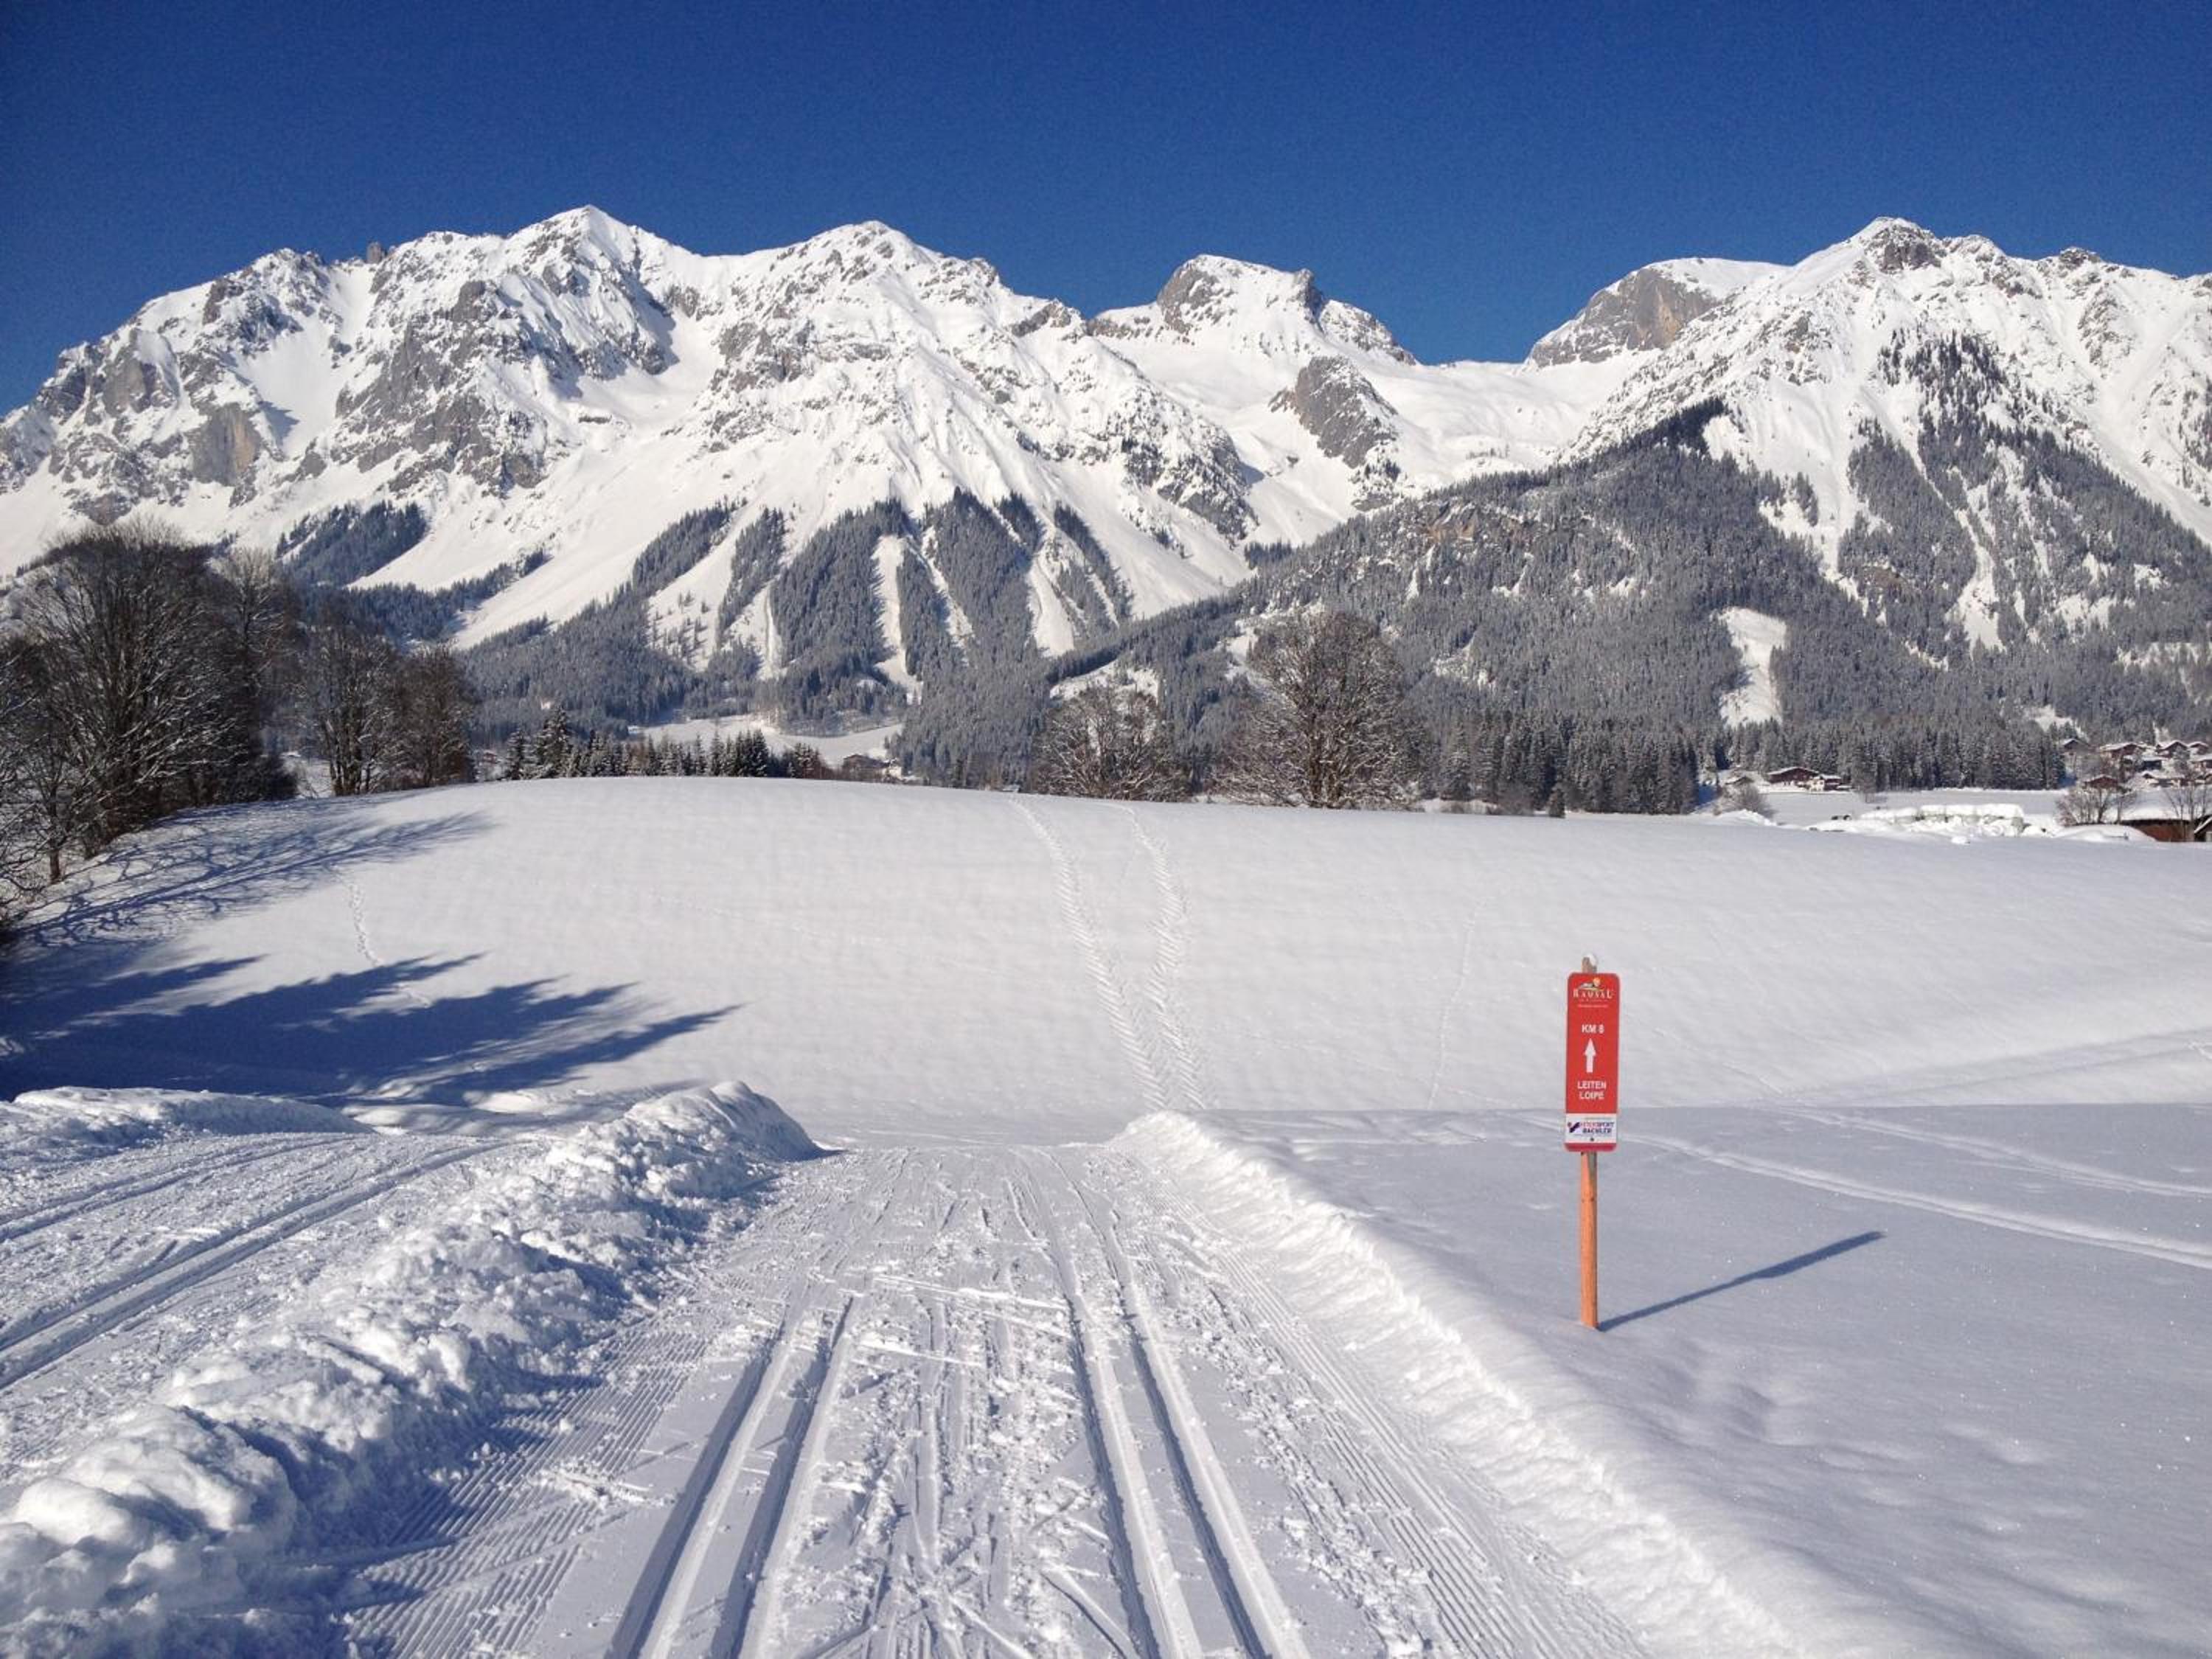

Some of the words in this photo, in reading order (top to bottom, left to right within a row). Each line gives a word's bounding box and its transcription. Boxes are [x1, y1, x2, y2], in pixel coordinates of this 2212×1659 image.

[1582, 1024, 1597, 1034] KM
[1577, 1080, 1607, 1090] LEITEN
[1579, 1091, 1605, 1100] LOIPE
